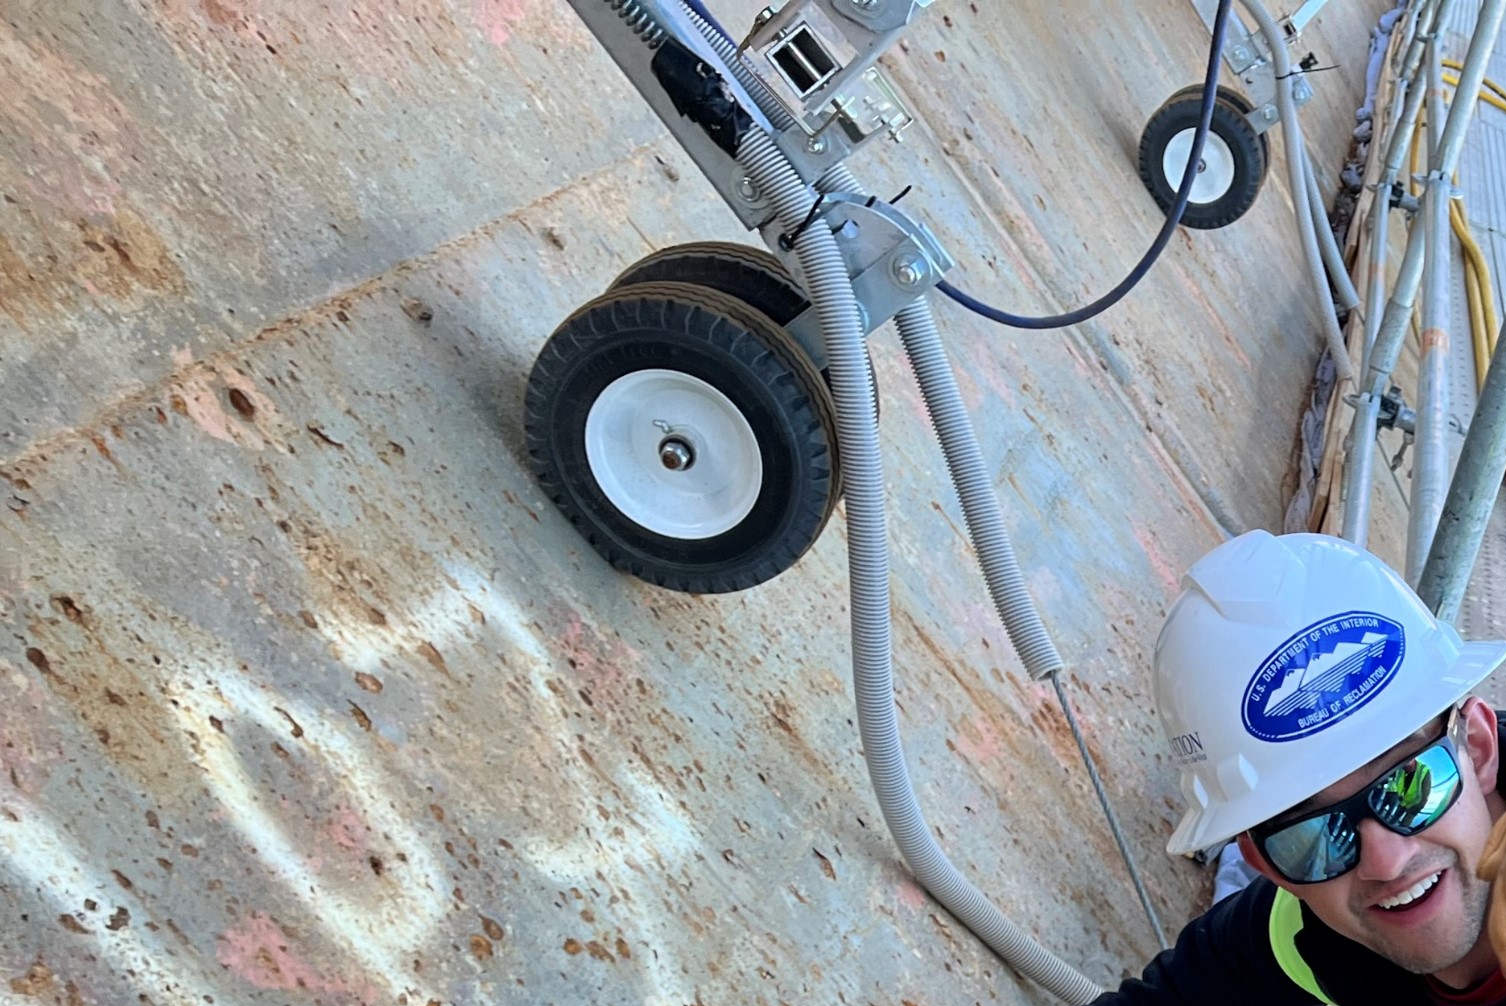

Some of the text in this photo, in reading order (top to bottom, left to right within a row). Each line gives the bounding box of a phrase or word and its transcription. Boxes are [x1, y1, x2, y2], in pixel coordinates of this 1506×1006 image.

[1250, 617, 1380, 702] U.S. DEPARTMENT OF THE INTERIOR
[1297, 665, 1388, 729] BUREAU OF RECLAMATION
